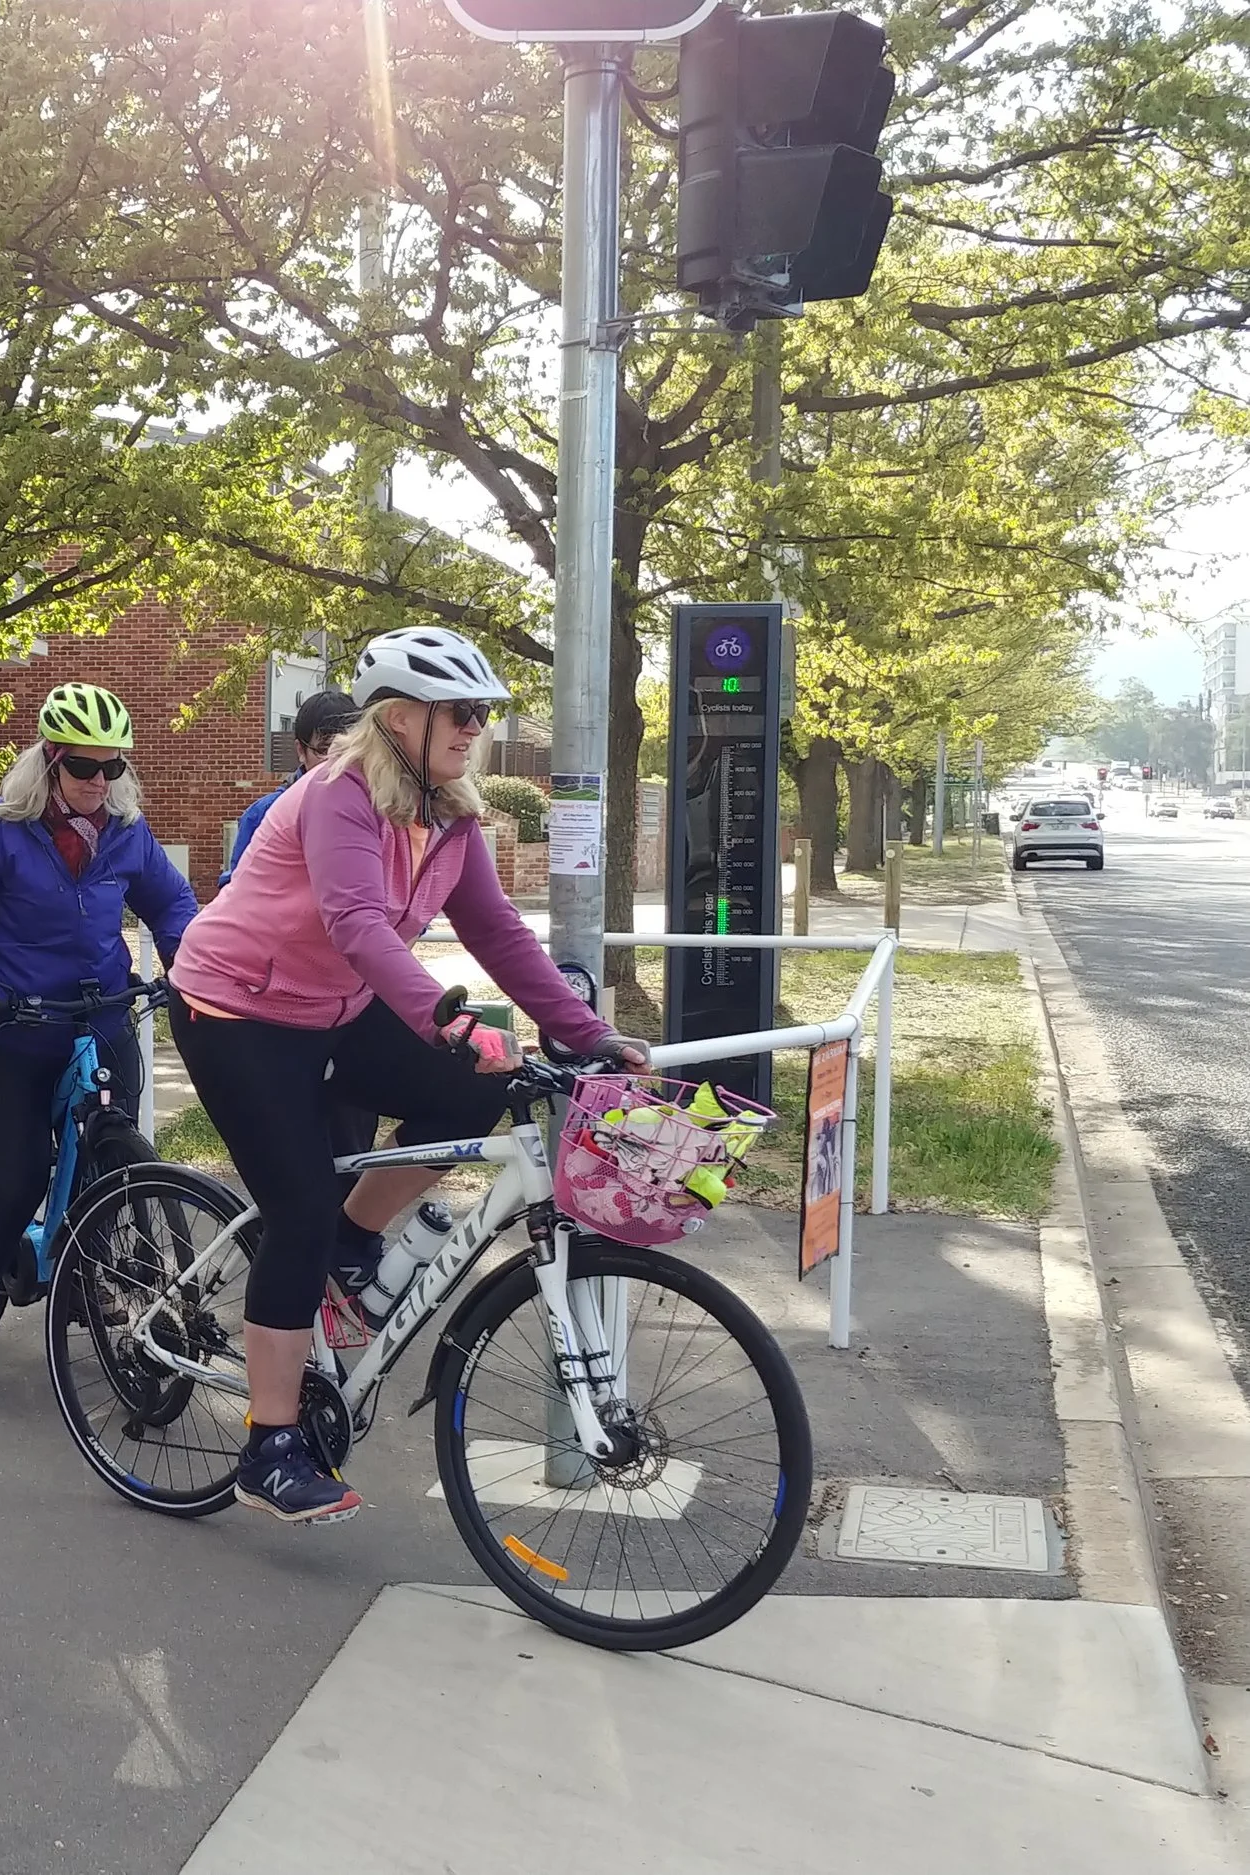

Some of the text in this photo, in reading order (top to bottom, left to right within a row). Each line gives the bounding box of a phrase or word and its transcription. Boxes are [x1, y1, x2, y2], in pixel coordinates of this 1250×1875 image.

[701, 704, 754, 713] Cyclists today
[705, 892, 716, 919] year
[384, 1187, 496, 1350] GIANT
[464, 1327, 490, 1374] GIANT
[86, 1435, 116, 1467] GIANT
[262, 1468, 294, 1497] N
